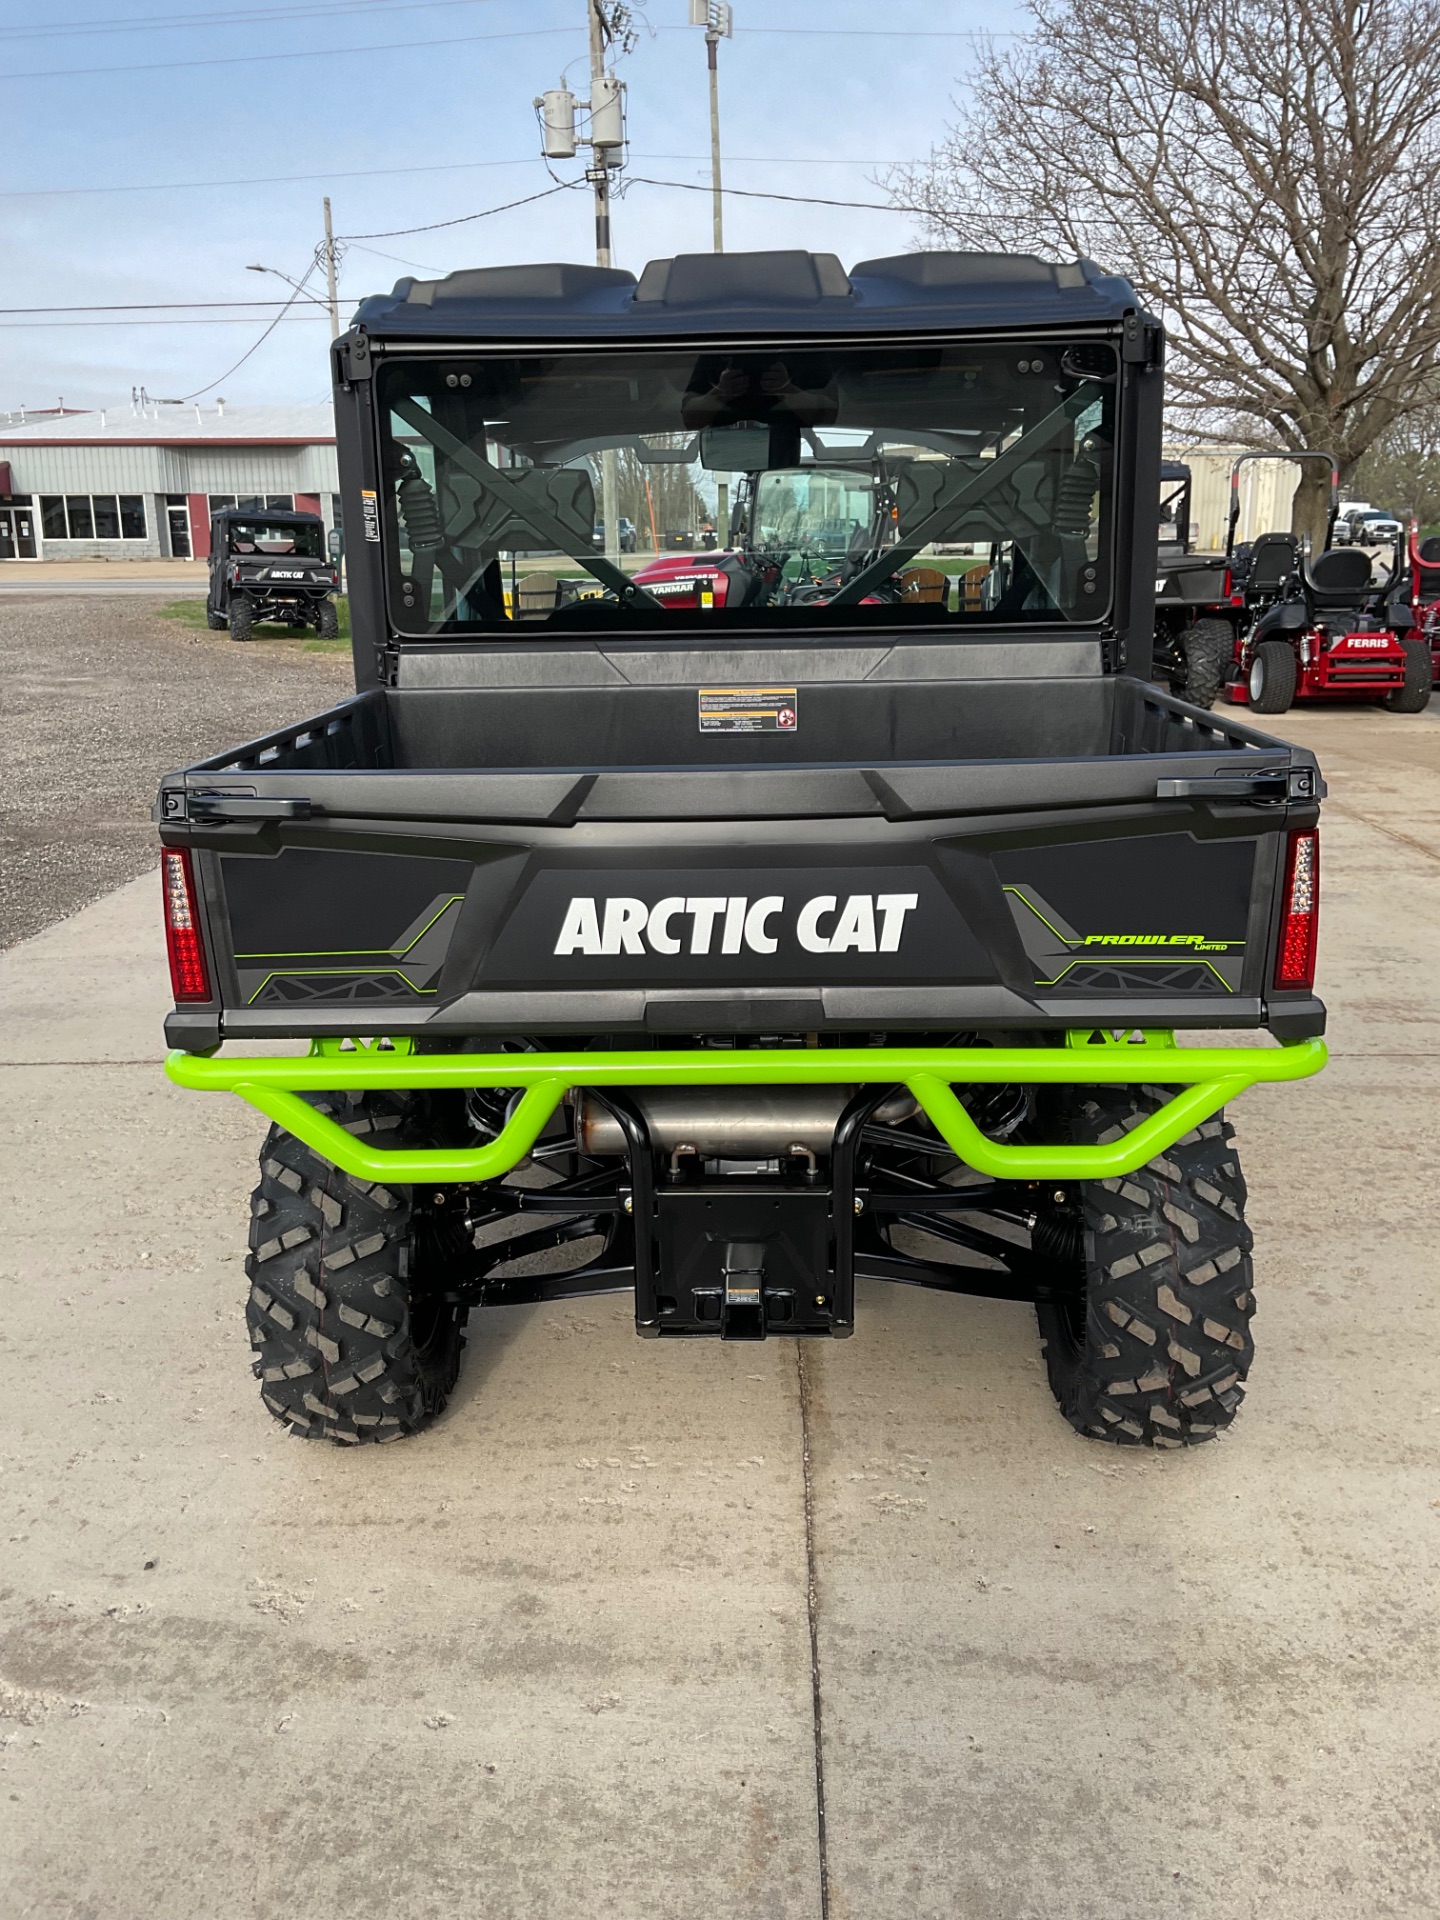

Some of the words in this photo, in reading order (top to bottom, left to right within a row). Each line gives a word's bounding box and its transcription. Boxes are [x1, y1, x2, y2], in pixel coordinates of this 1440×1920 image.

[271, 571, 292, 579] ARCTIC
[293, 571, 305, 579] CAT
[652, 584, 694, 595] YANMAR
[1347, 638, 1389, 648] FERRIS
[553, 895, 785, 955] ARCTIC
[796, 893, 919, 953] CAT
[1084, 935, 1205, 945] PROWLER
